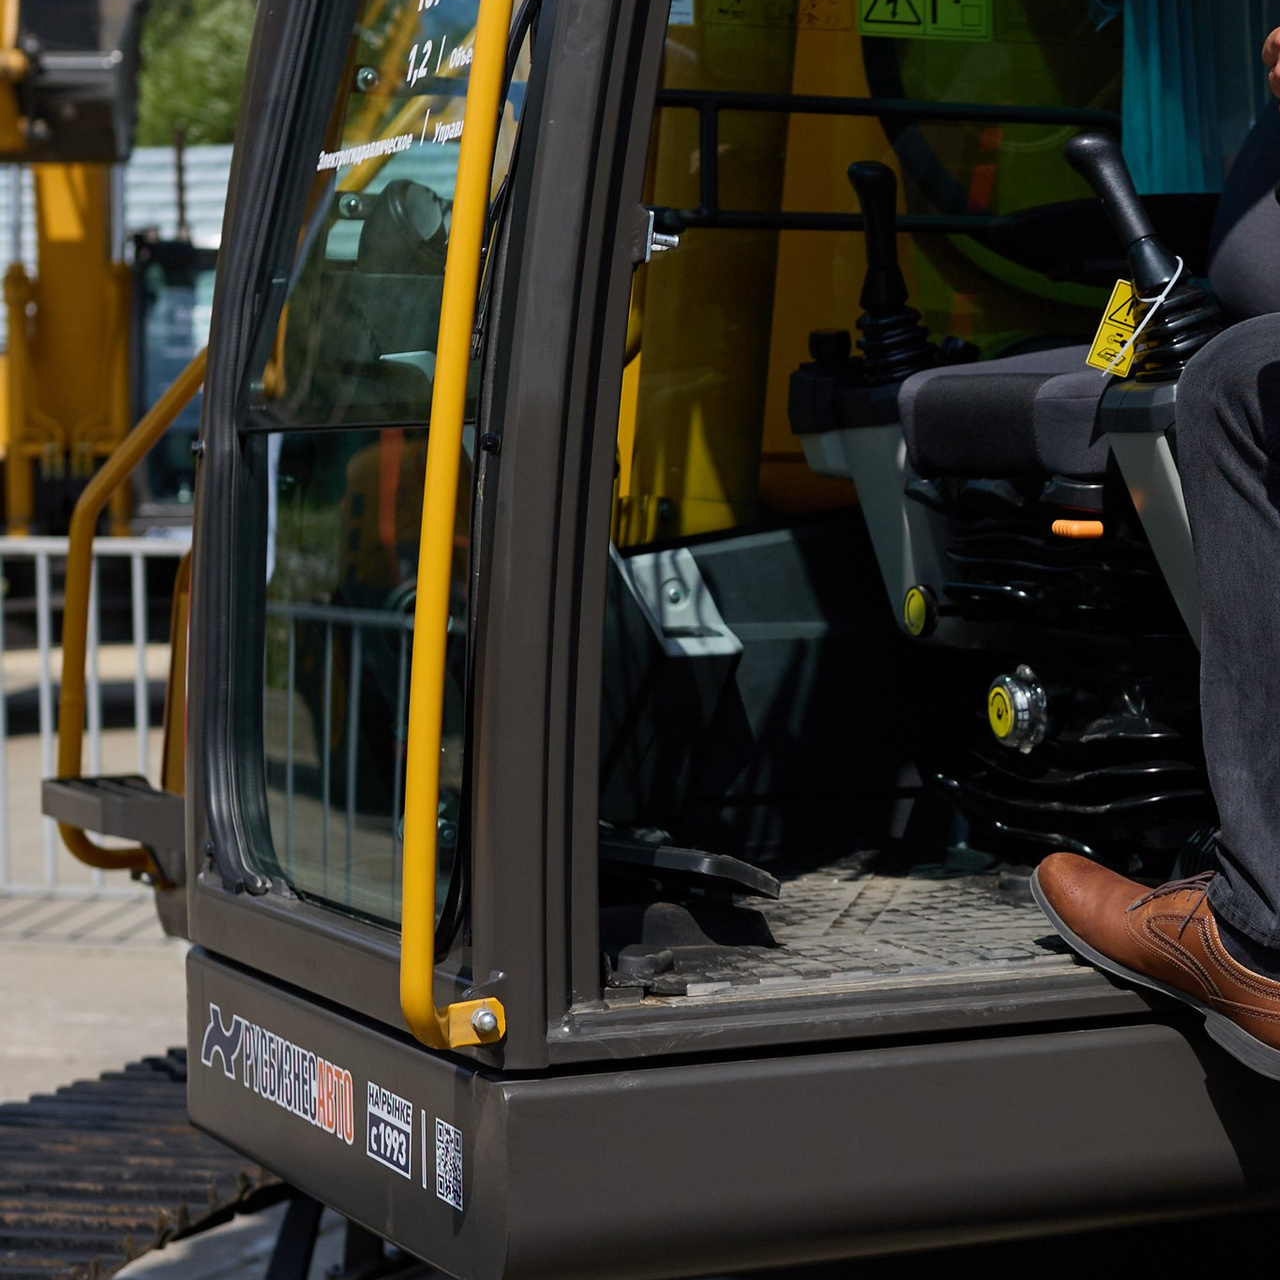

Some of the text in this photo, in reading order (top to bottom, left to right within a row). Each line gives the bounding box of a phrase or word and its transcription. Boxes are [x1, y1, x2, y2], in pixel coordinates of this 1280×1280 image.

[406, 39, 474, 88] 1,2 Объе
[243, 1021, 354, 1144] РУСБИЗНЕСАВТО
